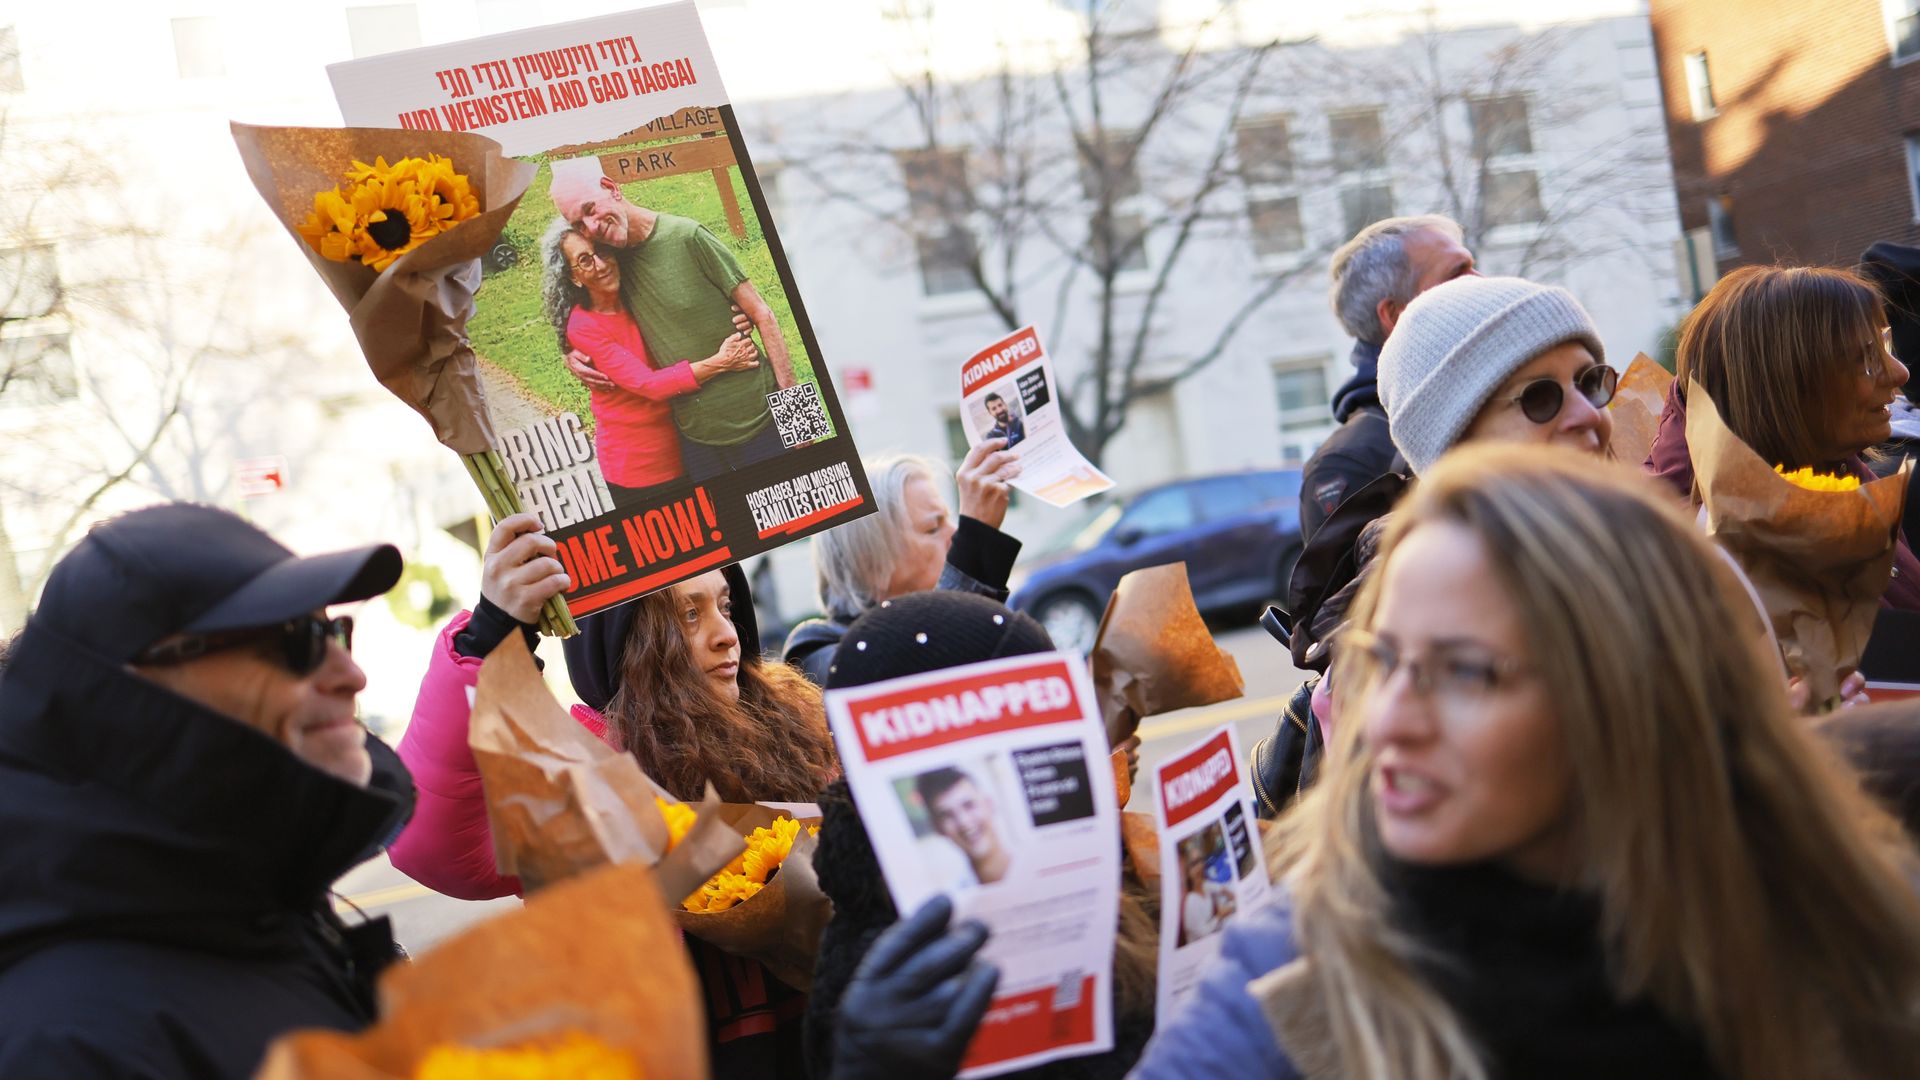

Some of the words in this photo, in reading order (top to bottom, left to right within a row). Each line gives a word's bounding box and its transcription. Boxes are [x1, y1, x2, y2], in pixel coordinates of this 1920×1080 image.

[435, 67, 475, 99] חגי
[471, 59, 515, 91] וגדי
[512, 44, 599, 88] ווינשטיין
[441, 87, 548, 132] WEINSTEIN
[548, 79, 588, 112] AND
[587, 71, 629, 103] GAD
[627, 57, 697, 96] HAGGAI
[619, 151, 676, 175] PARK
[963, 336, 1037, 388] KIDNAPPED
[517, 468, 604, 533] HEM
[745, 481, 794, 511] HOSTAGES
[792, 474, 813, 495] AND
[810, 461, 851, 488] MISSING
[752, 492, 813, 532] FAMILIES
[810, 477, 860, 511] FORUM
[555, 524, 628, 593] OME
[621, 486, 723, 568] NOW!
[860, 676, 1071, 747] KIDNAPPED
[1163, 747, 1233, 811] KIDNAPPED
